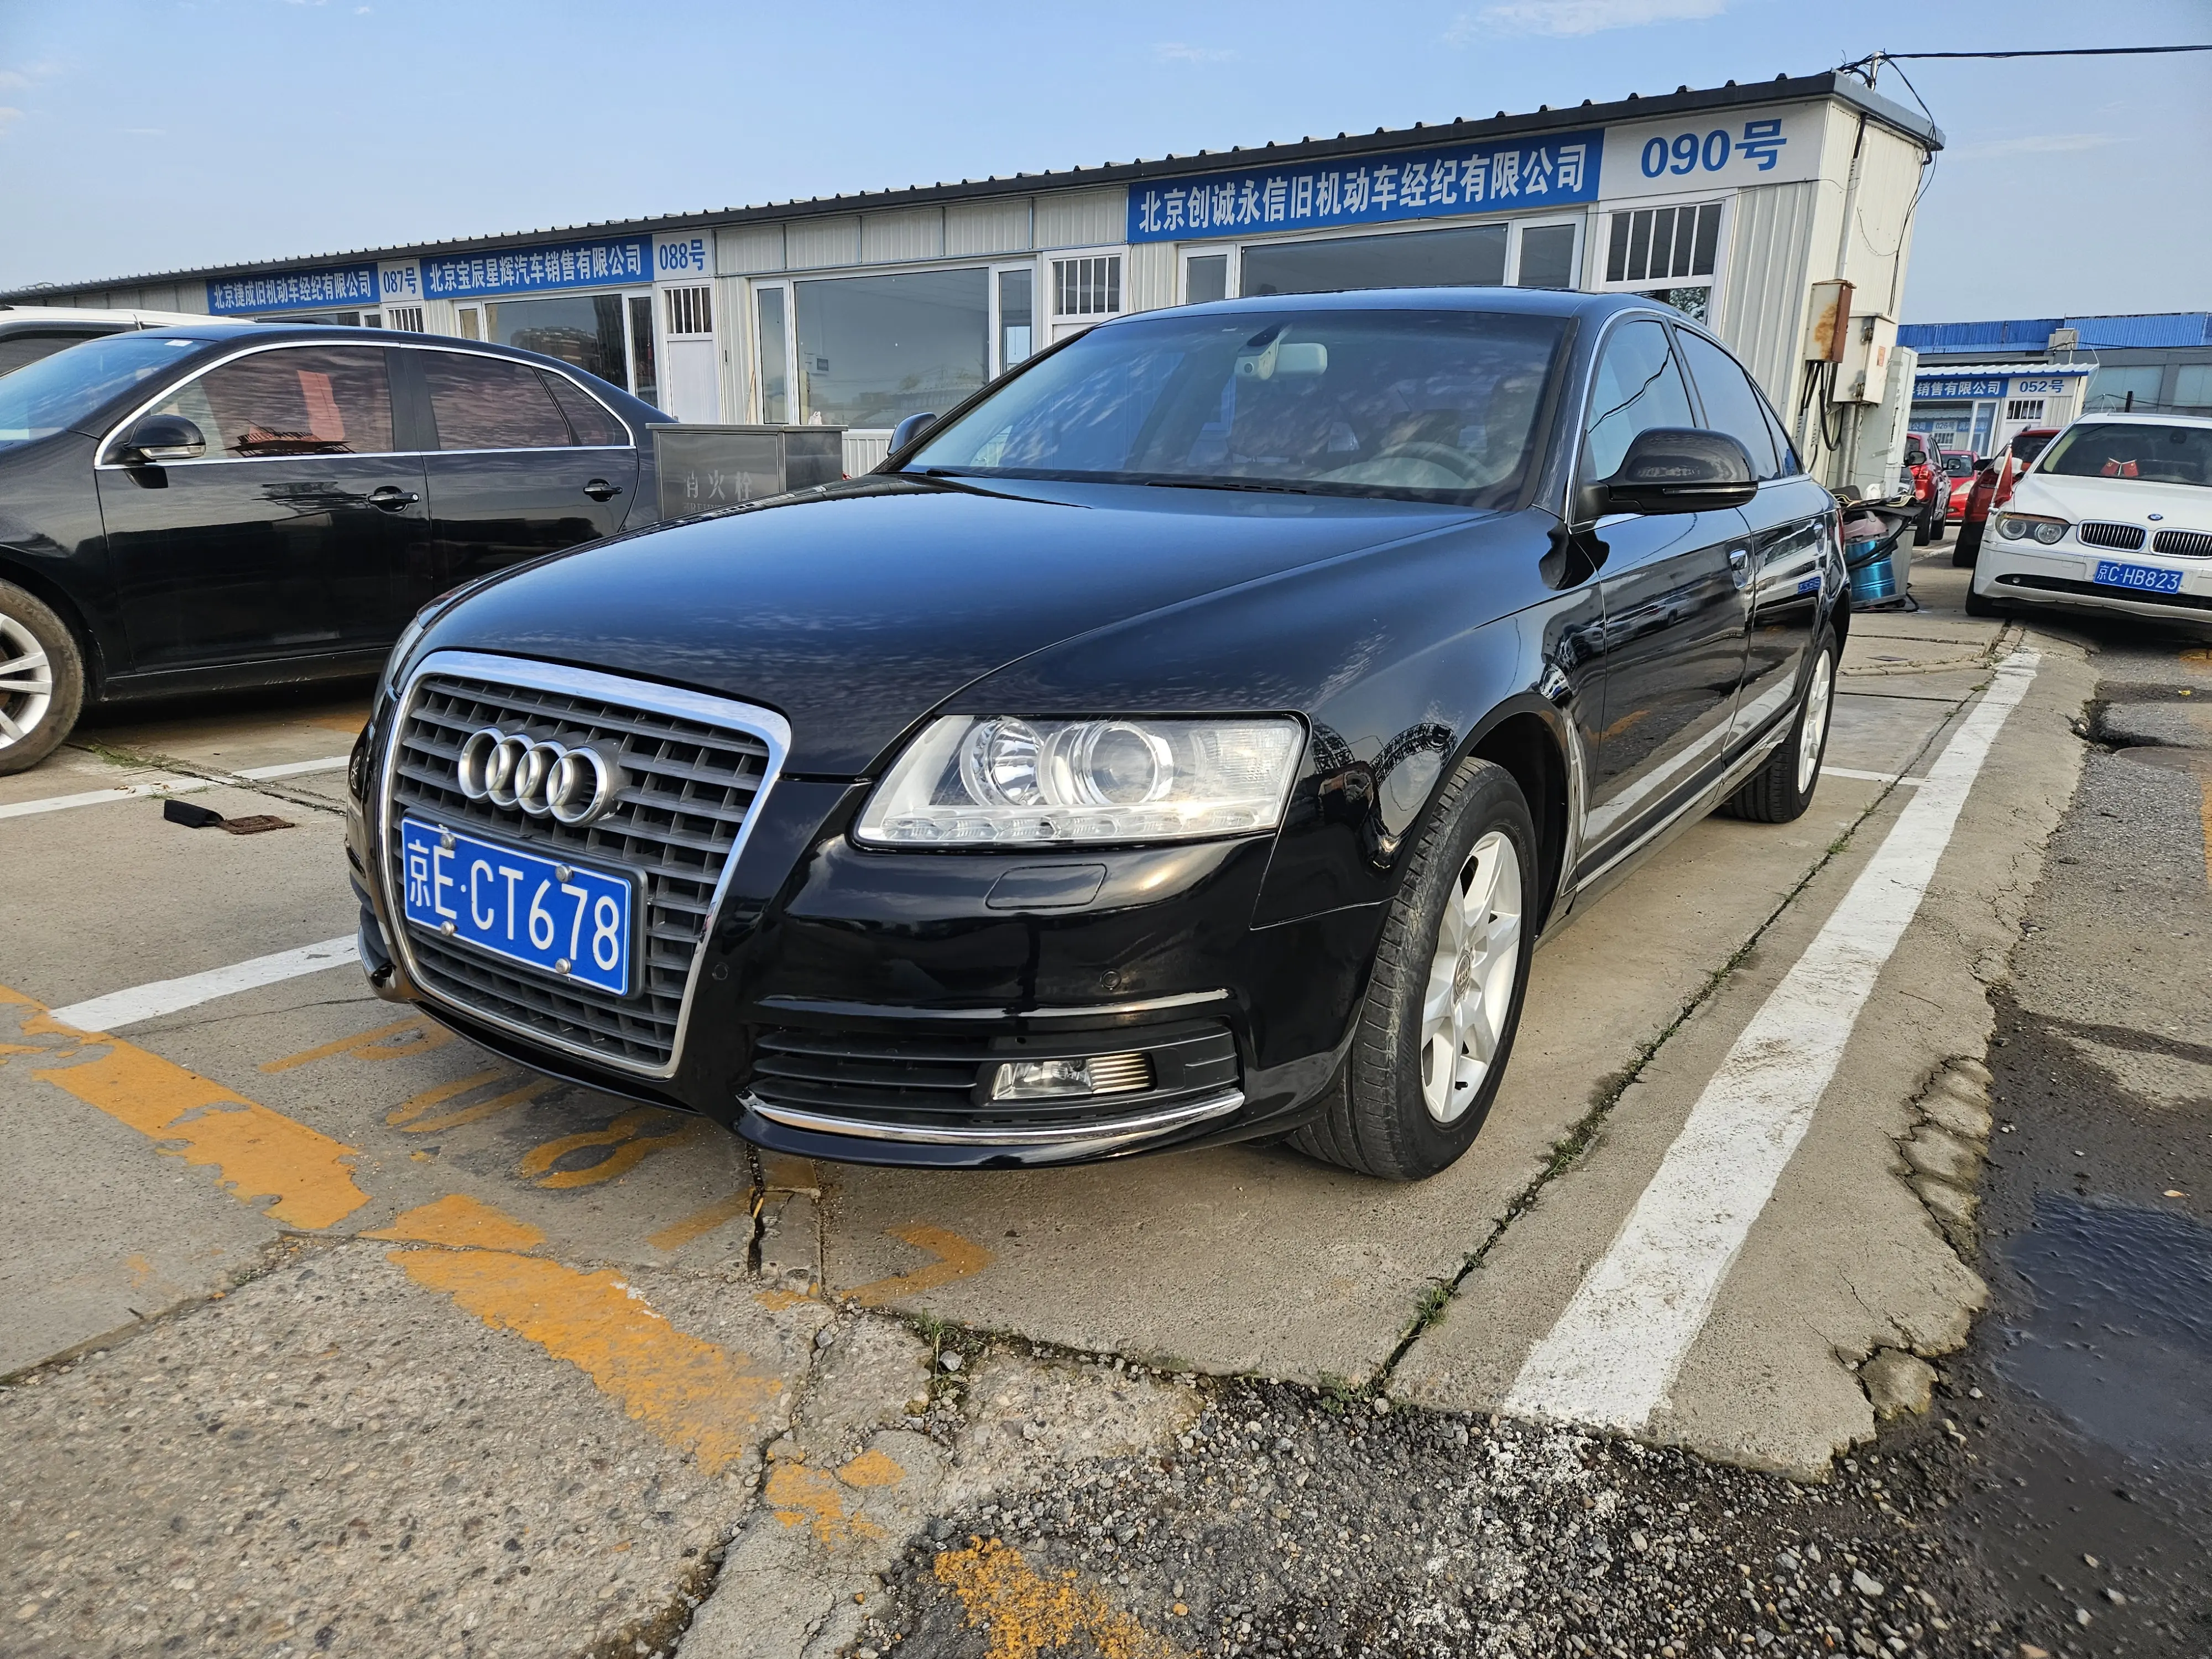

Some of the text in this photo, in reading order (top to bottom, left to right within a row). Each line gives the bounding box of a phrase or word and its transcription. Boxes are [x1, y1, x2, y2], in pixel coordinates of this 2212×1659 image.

[1641, 118, 1787, 178] 090号
[1139, 144, 1587, 232] 北京创诚永信旧机动车经纪有限公司
[429, 243, 641, 293] 北京宝辰星辉汽车销售有限公司
[659, 239, 706, 271] 088号
[383, 267, 417, 294] 087号
[1913, 380, 2001, 397] 销售有限公司
[2019, 379, 2064, 393] 052号
[407, 839, 620, 971] 京E·CT678
